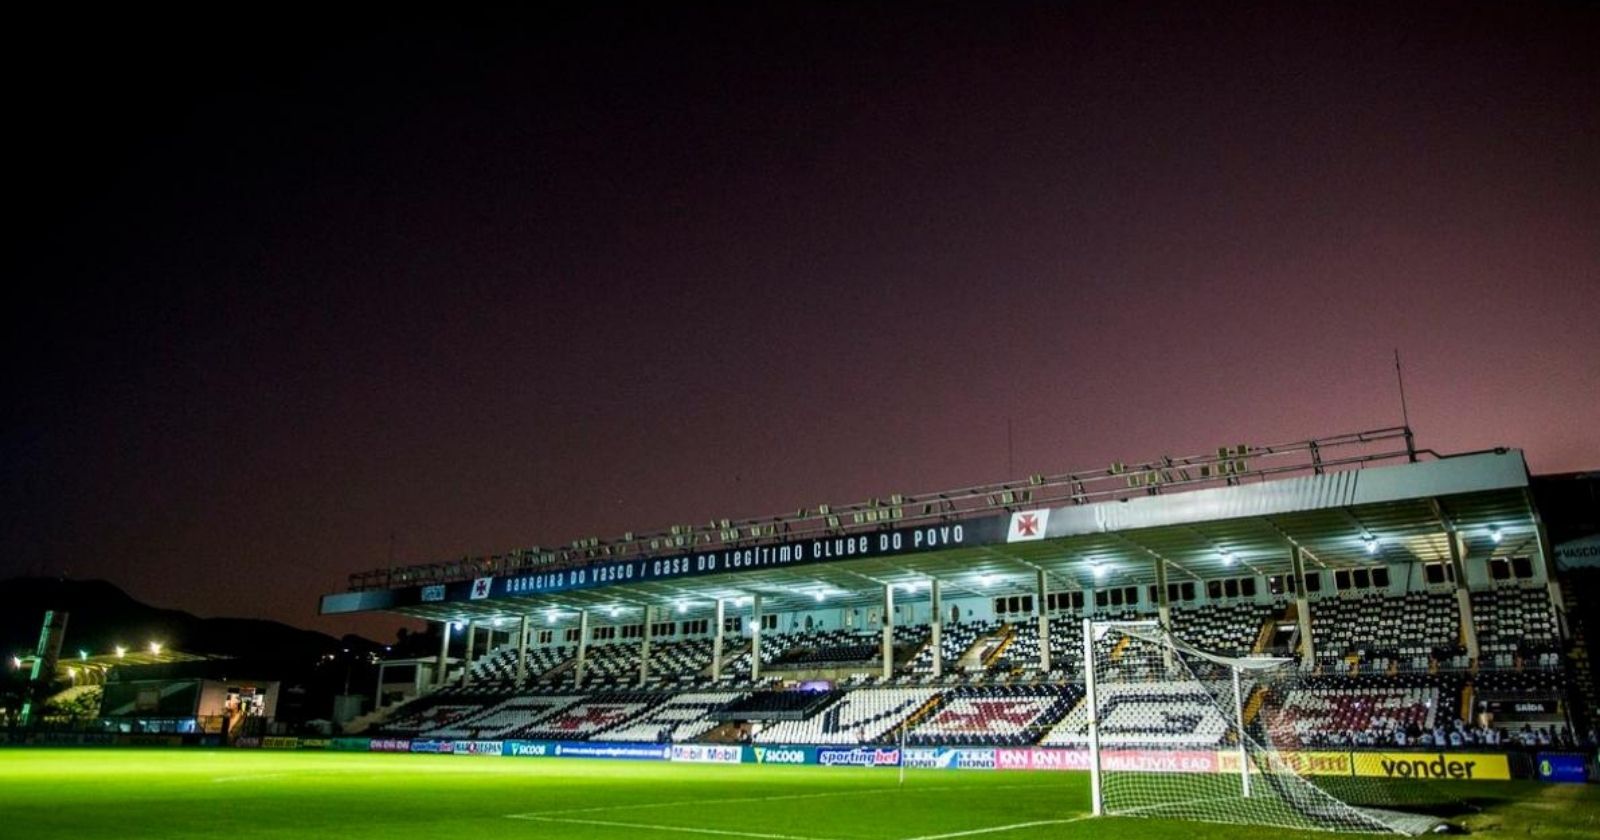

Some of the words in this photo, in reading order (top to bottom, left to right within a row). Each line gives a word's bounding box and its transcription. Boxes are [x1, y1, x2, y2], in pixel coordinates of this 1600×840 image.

[570, 569, 585, 584] DO
[698, 553, 716, 570] DO
[880, 532, 902, 550] DO
[914, 524, 964, 548] POVO
[674, 748, 702, 761] Mobil
[707, 748, 738, 762] Mobil
[765, 749, 805, 763] SICOOB
[820, 748, 899, 766] sportingbet
[1108, 757, 1176, 769] MULTIVIX
[1182, 757, 1210, 769] EAD
[1381, 753, 1476, 778] vonder
